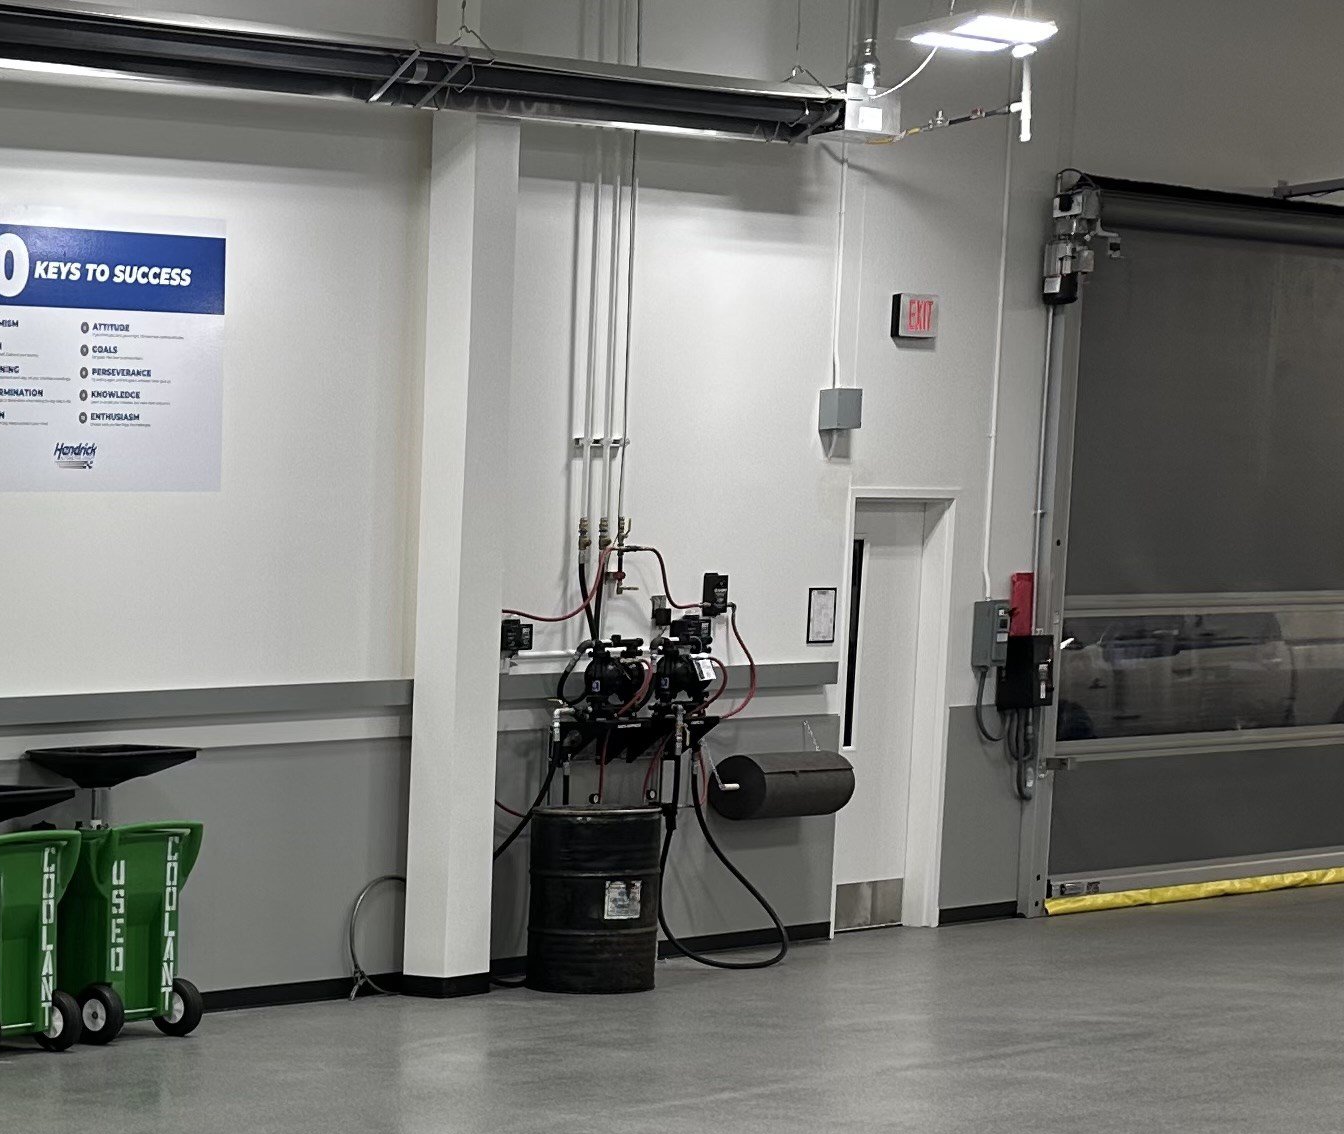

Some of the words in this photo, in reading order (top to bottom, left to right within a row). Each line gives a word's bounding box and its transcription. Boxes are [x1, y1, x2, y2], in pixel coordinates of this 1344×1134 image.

[33, 260, 81, 281] KEYS
[85, 263, 110, 282] TO
[112, 264, 192, 287] SUCCESS
[92, 322, 130, 332] ATTITUDE
[908, 299, 934, 331] EXIT
[91, 367, 152, 377] PERSEVERANCE
[90, 412, 140, 422] ENTHUSIASM
[111, 859, 126, 972] USED
[161, 836, 180, 1011] COOLANT
[40, 847, 56, 1027] COOLANT
